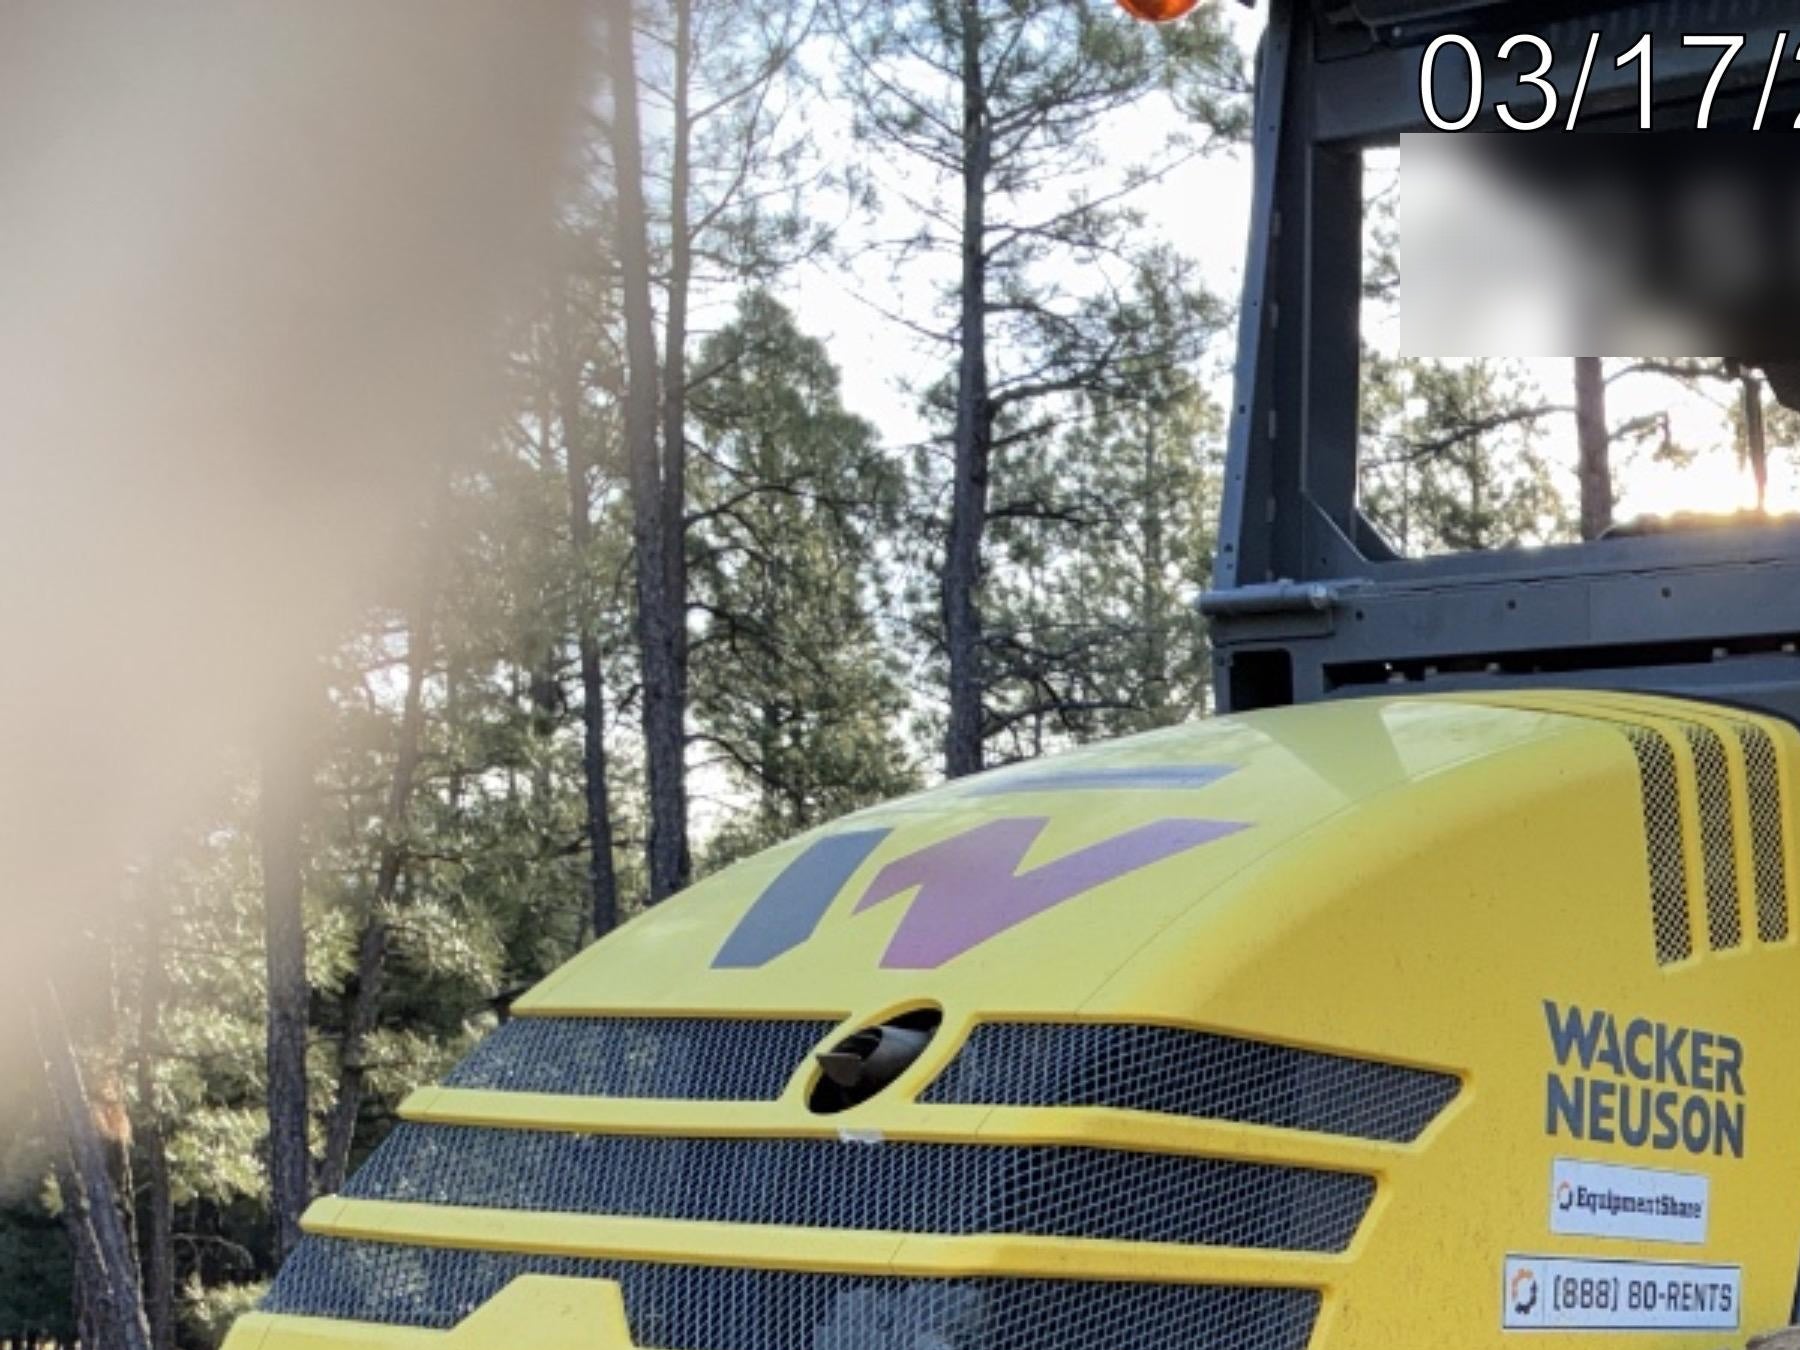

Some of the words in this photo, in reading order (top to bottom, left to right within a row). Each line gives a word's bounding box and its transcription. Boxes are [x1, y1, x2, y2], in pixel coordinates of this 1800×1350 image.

[1543, 999, 1746, 1096] WACKER
[1544, 1072, 1746, 1159] NEUSON
[1553, 1275, 1620, 1311] (888)
